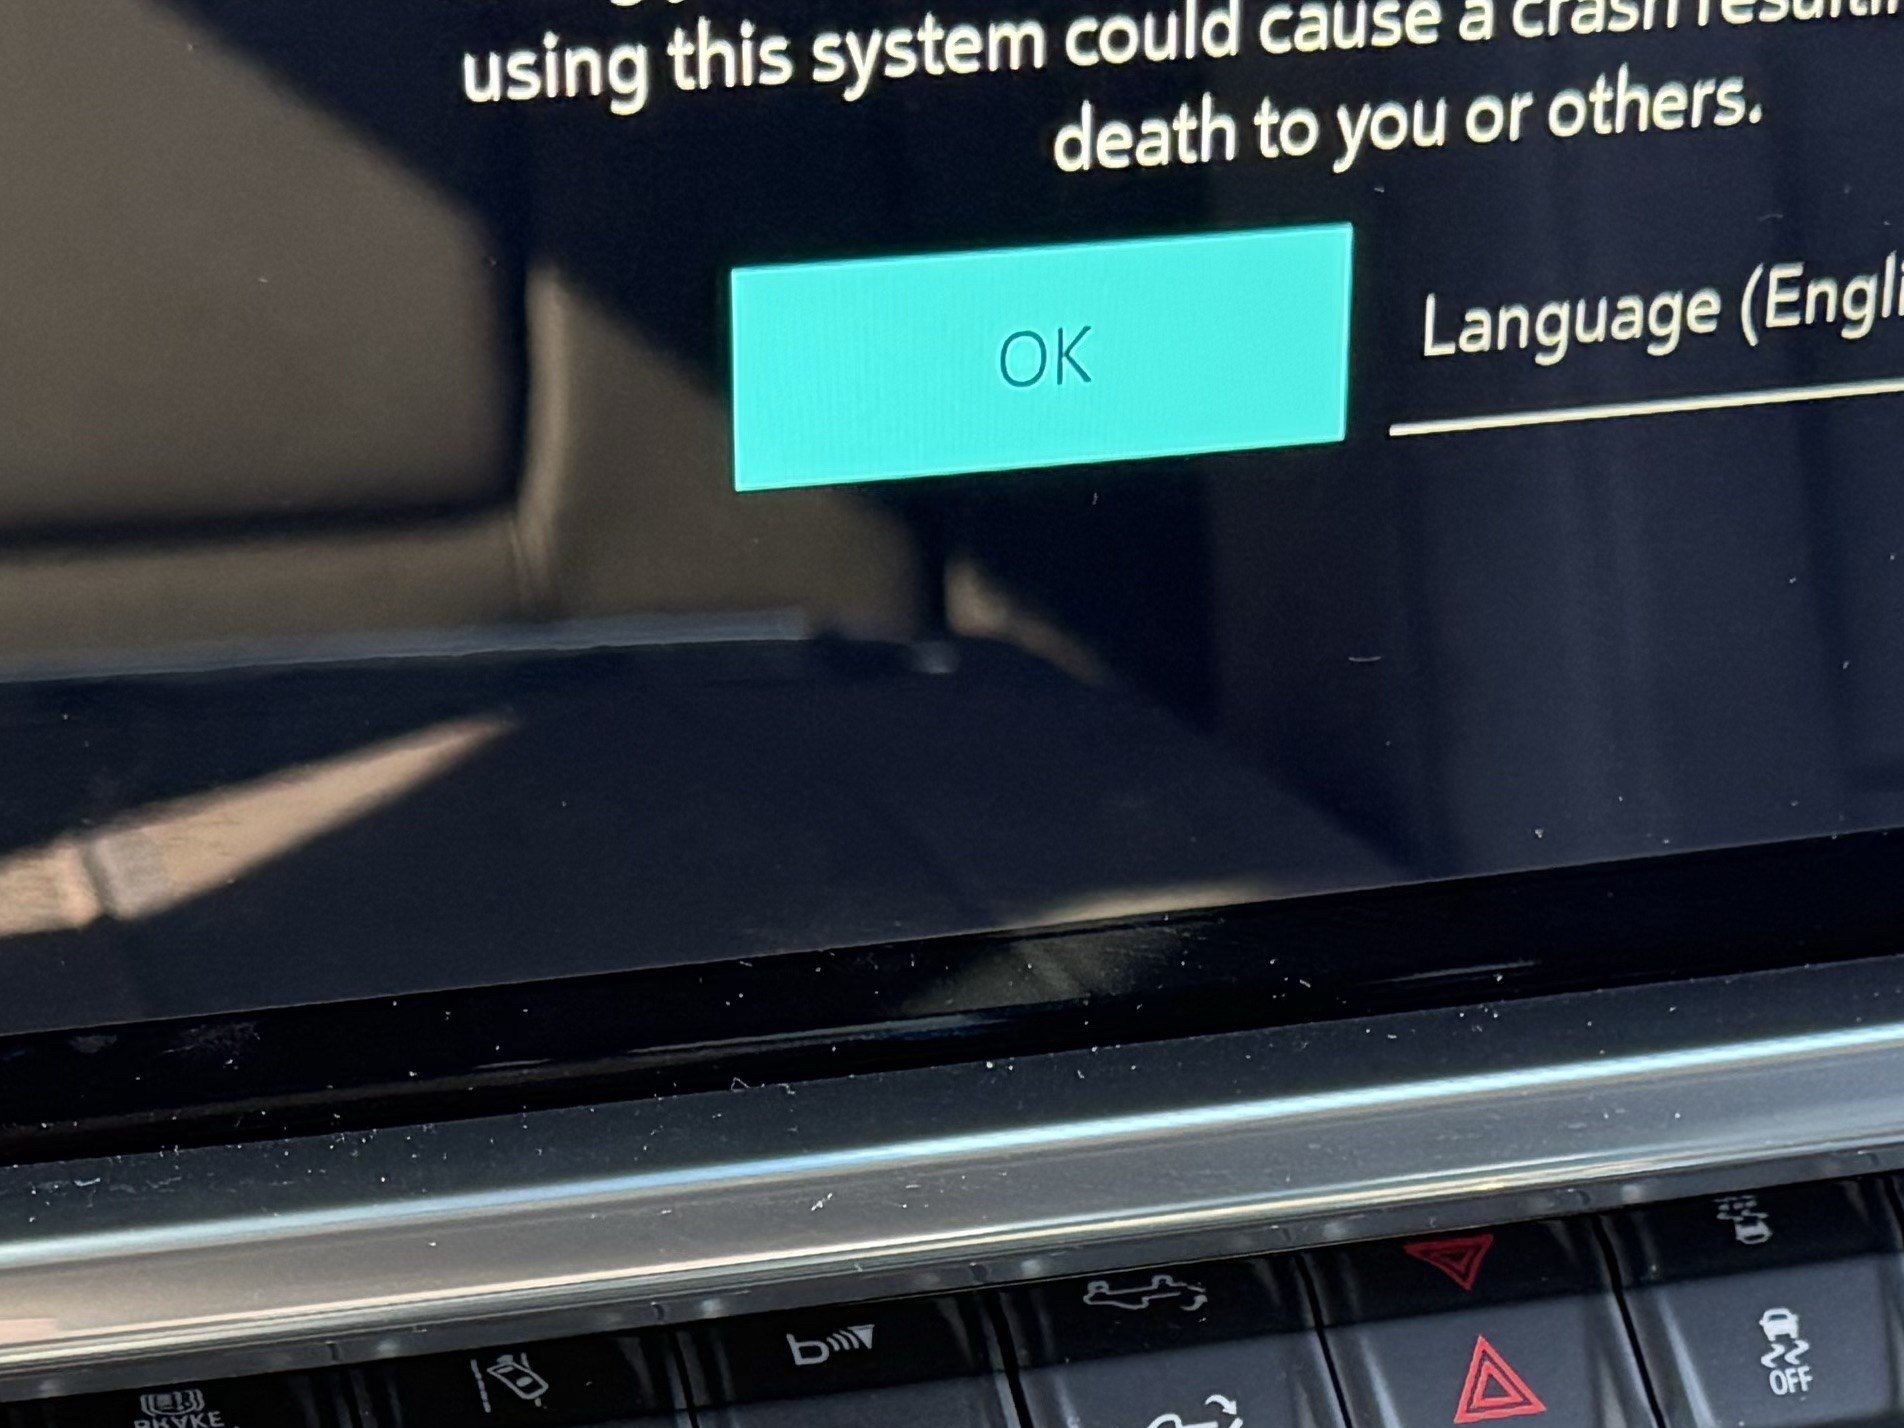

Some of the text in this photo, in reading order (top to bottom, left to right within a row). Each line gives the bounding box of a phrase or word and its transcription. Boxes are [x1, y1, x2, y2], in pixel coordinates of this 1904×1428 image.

[464, 31, 648, 115] using
[667, 16, 793, 90] this
[813, 12, 1045, 101] system
[1066, 0, 1240, 66] could
[1260, 0, 1442, 53] cause
[1459, 0, 1494, 40] a
[1054, 63, 1761, 173] death to you or others.
[1001, 326, 1091, 387] OK
[1424, 290, 1720, 365] Language
[1769, 1365, 1813, 1396] OFF
